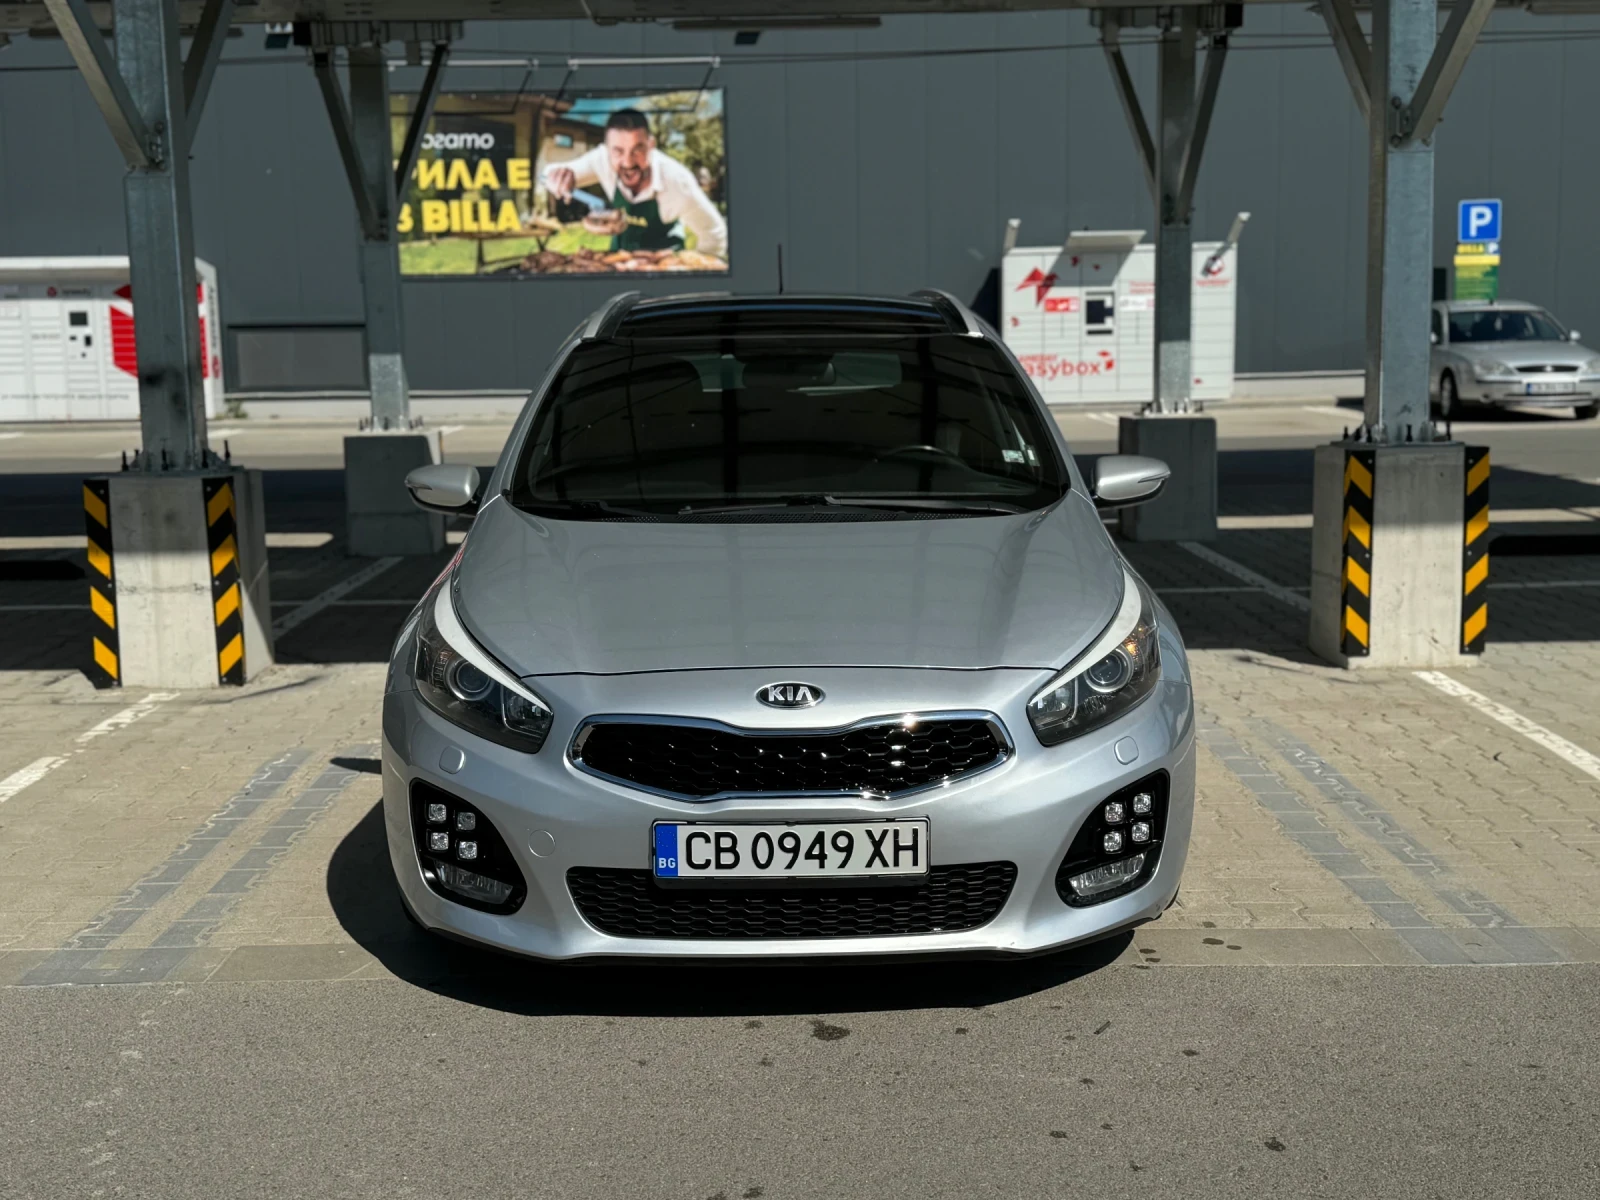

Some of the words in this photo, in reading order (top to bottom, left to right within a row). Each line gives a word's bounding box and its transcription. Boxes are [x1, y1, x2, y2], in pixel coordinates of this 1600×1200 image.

[421, 199, 522, 233] BILLA
[1470, 205, 1493, 238] P
[1021, 359, 1100, 382] asybox
[768, 686, 815, 703] KIA
[685, 831, 741, 870] CB
[751, 830, 854, 870] 0949
[864, 826, 919, 869] XH
[658, 857, 676, 869] BG
